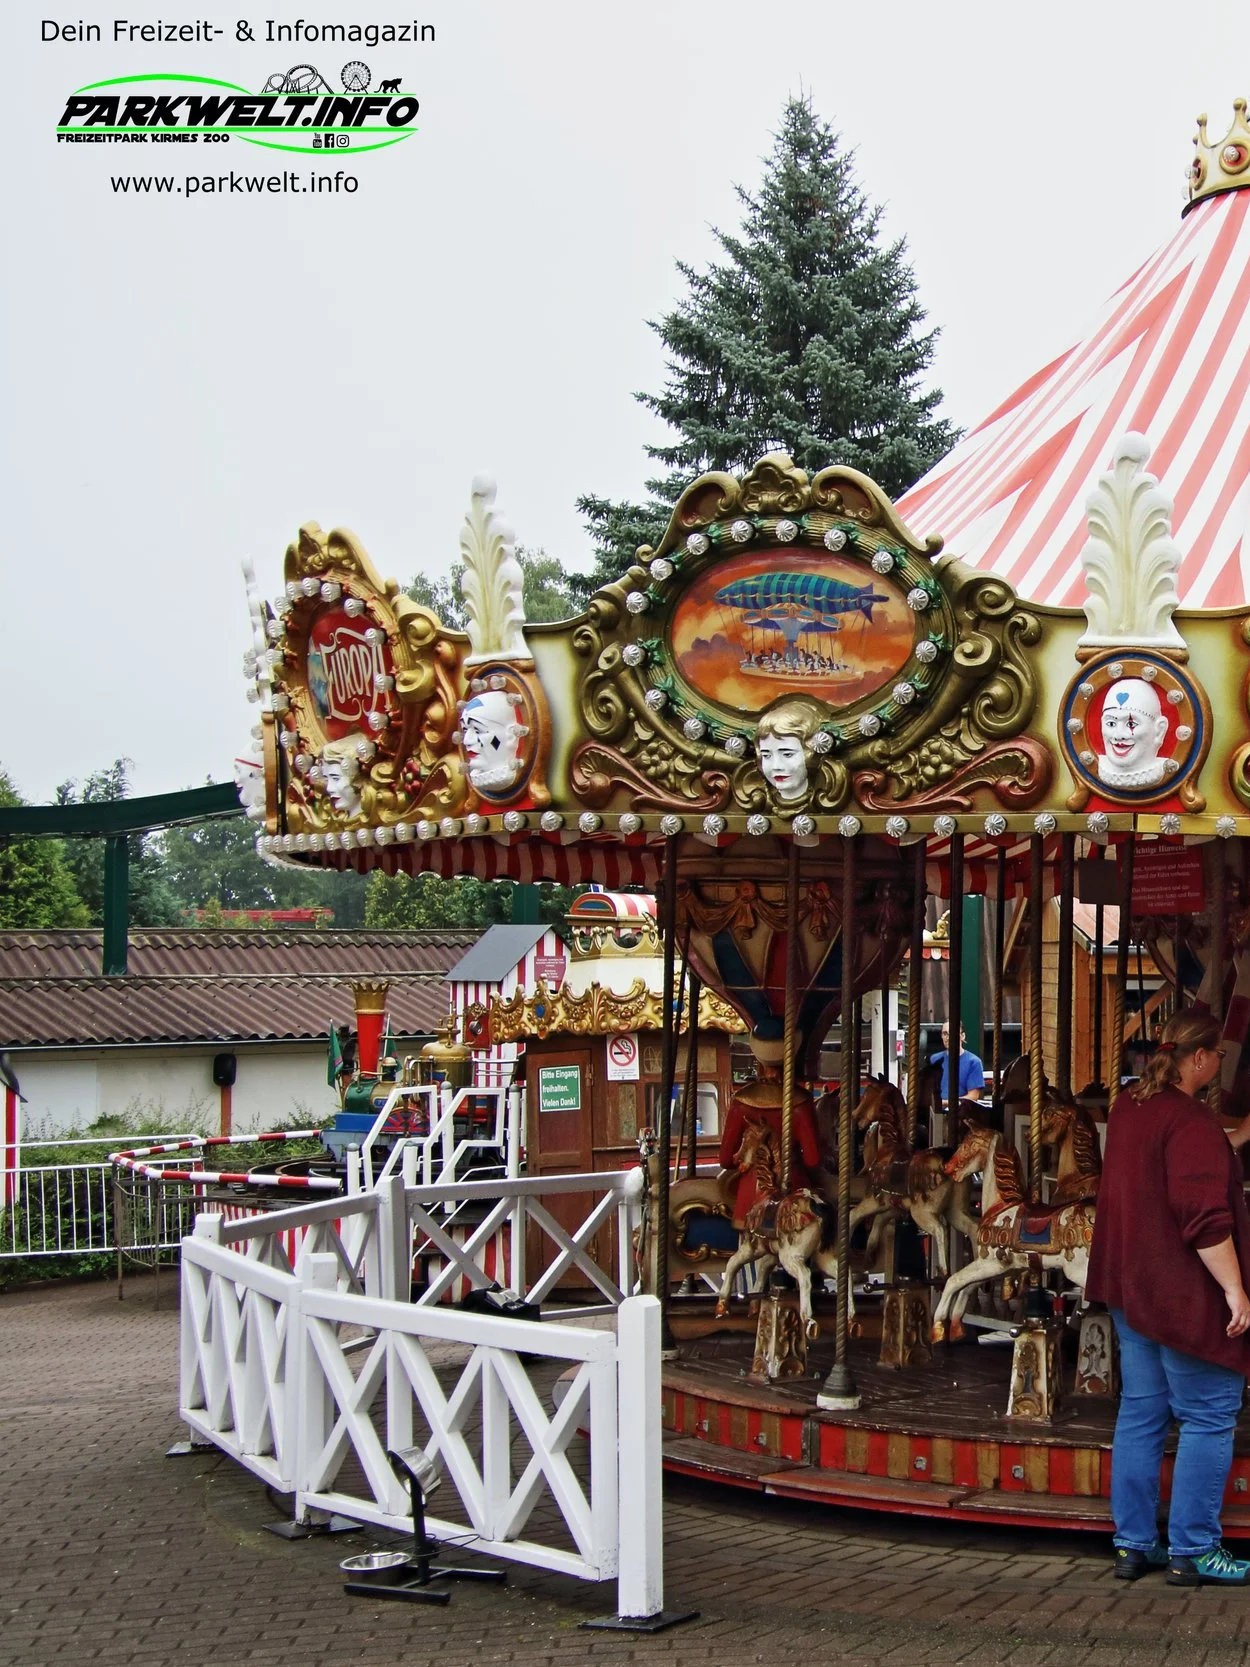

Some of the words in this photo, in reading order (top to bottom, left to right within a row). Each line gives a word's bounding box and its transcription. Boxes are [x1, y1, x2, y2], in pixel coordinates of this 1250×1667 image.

[320, 628, 391, 721] EUROPA
[541, 1071, 555, 1079] Bitte
[556, 1069, 578, 1080] Eingang
[542, 1084, 569, 1093] freihalten.
[542, 1099, 560, 1107] Vielen
[560, 1097, 576, 1106] Dank!
